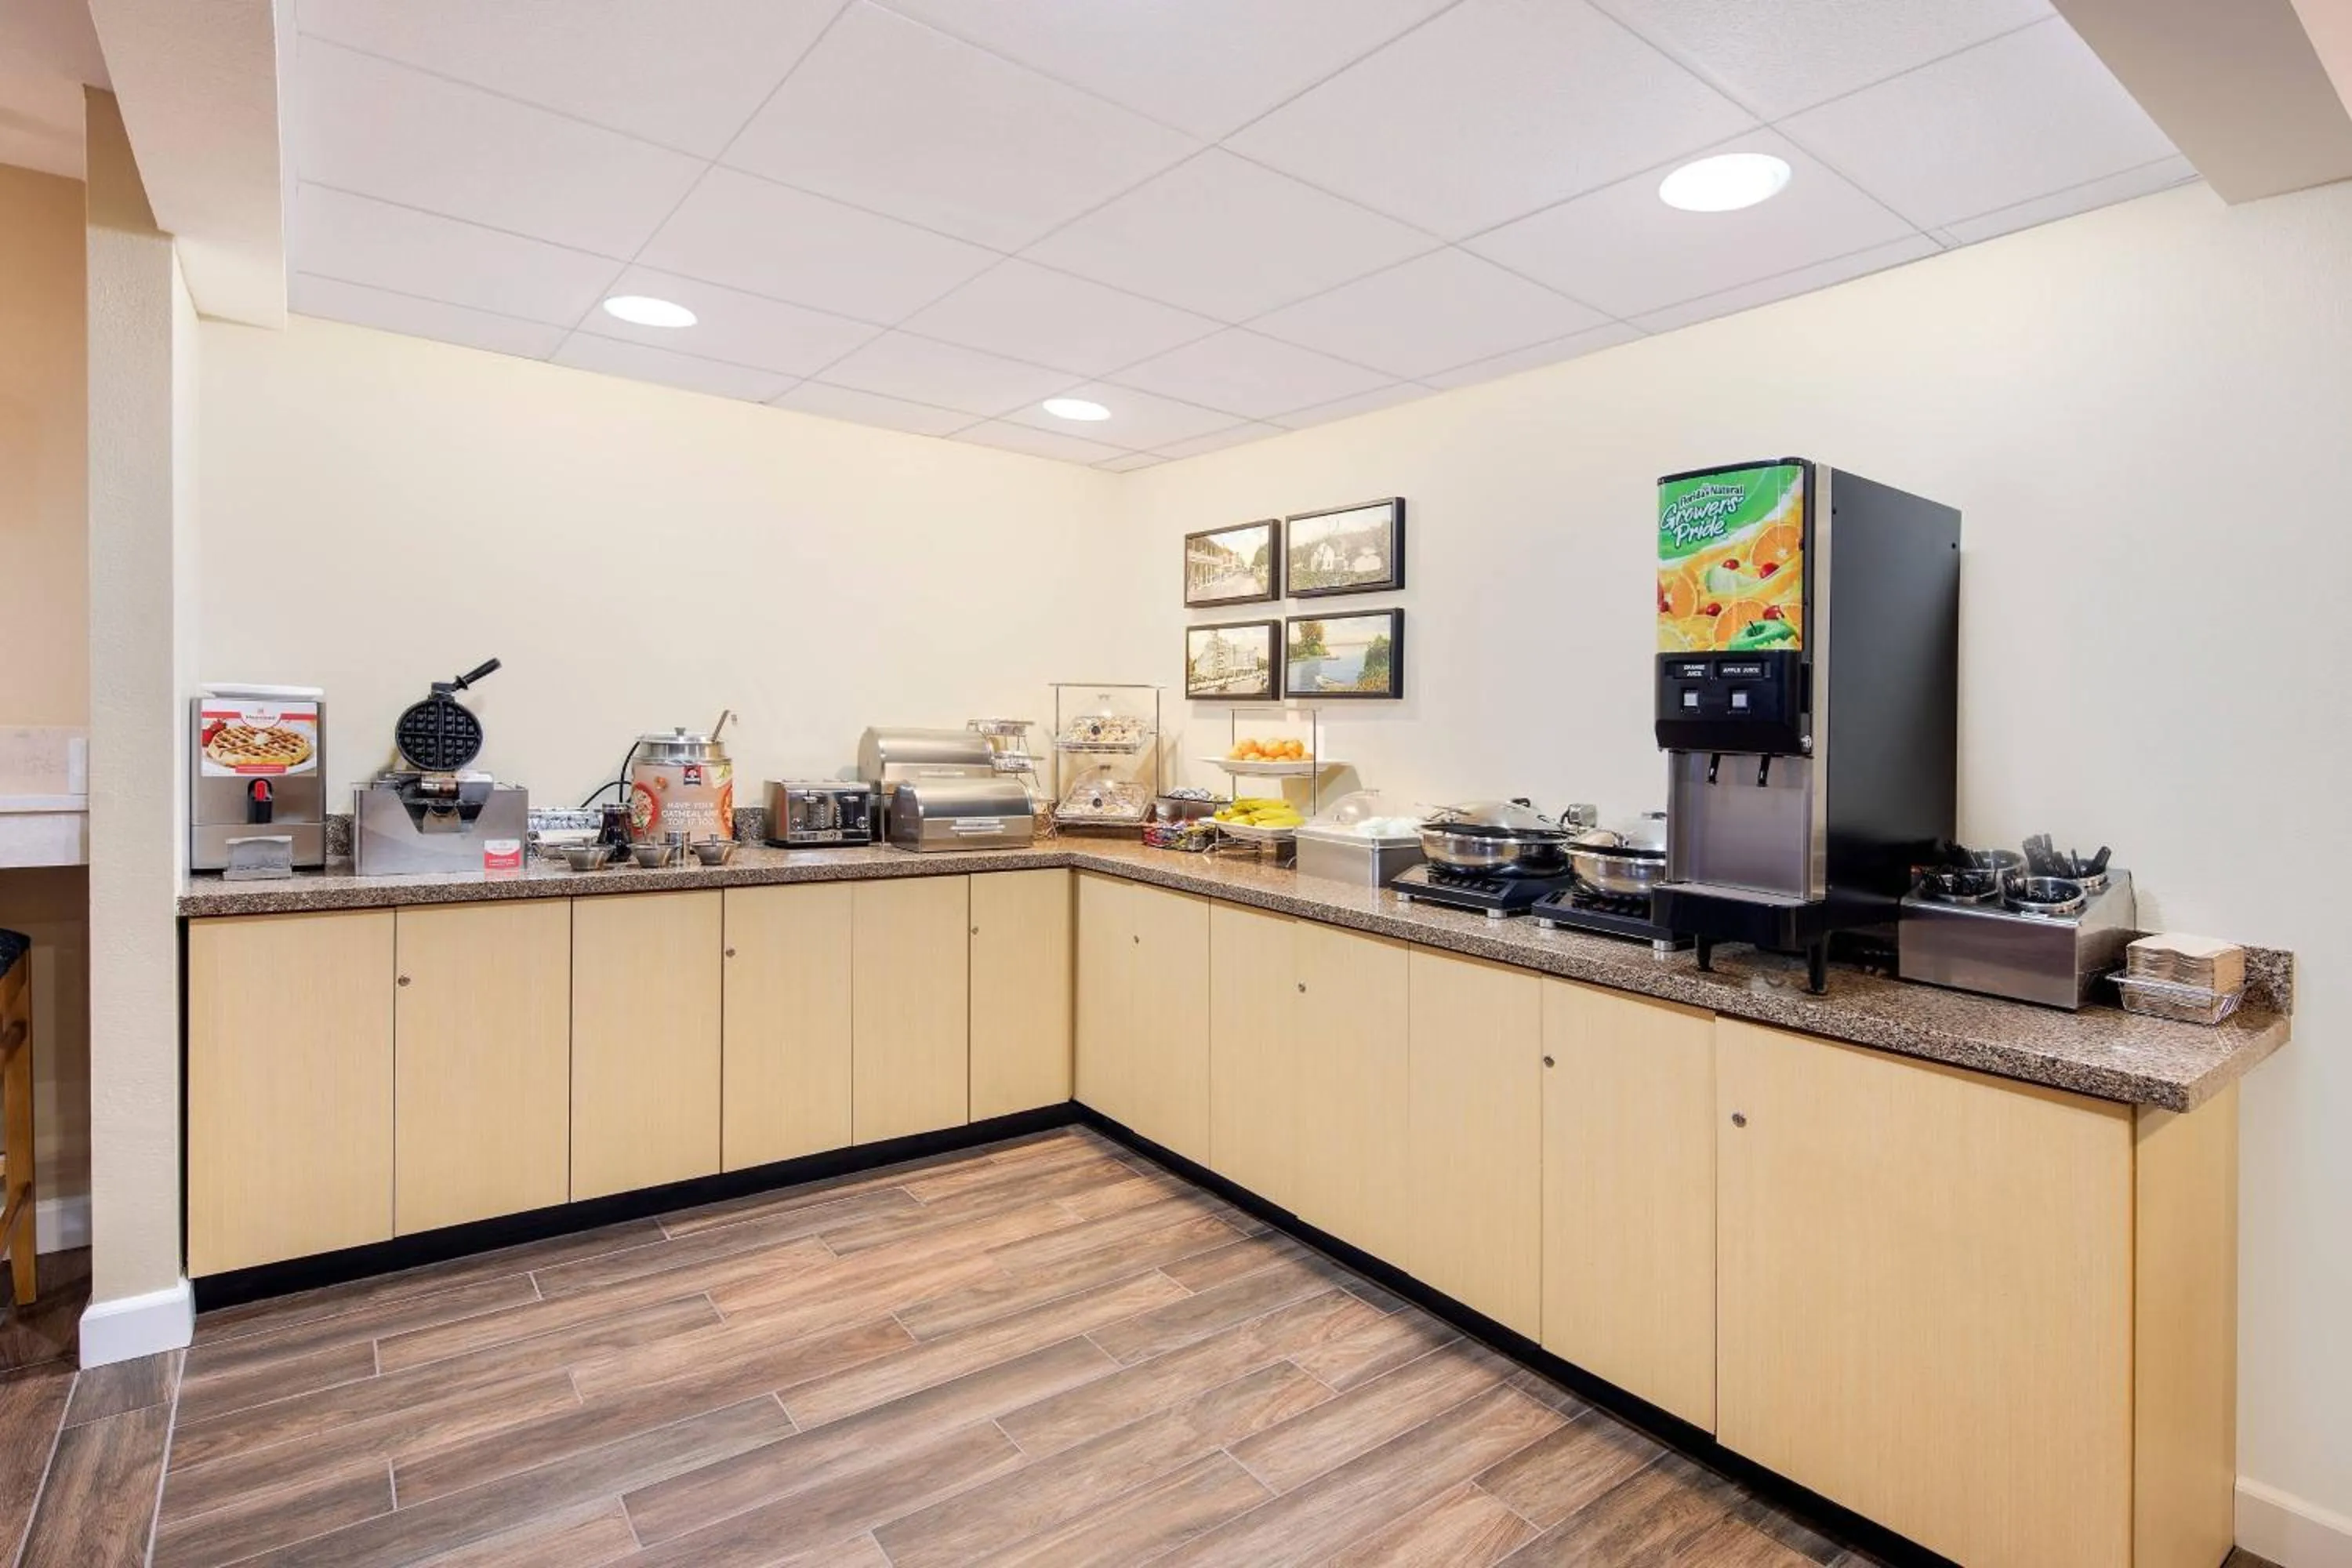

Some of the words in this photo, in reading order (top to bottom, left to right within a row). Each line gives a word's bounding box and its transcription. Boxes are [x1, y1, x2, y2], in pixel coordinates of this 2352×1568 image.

[1711, 485, 1744, 496] Natural
[1672, 514, 1726, 548] Pride
[662, 809, 700, 818] OATMEAL
